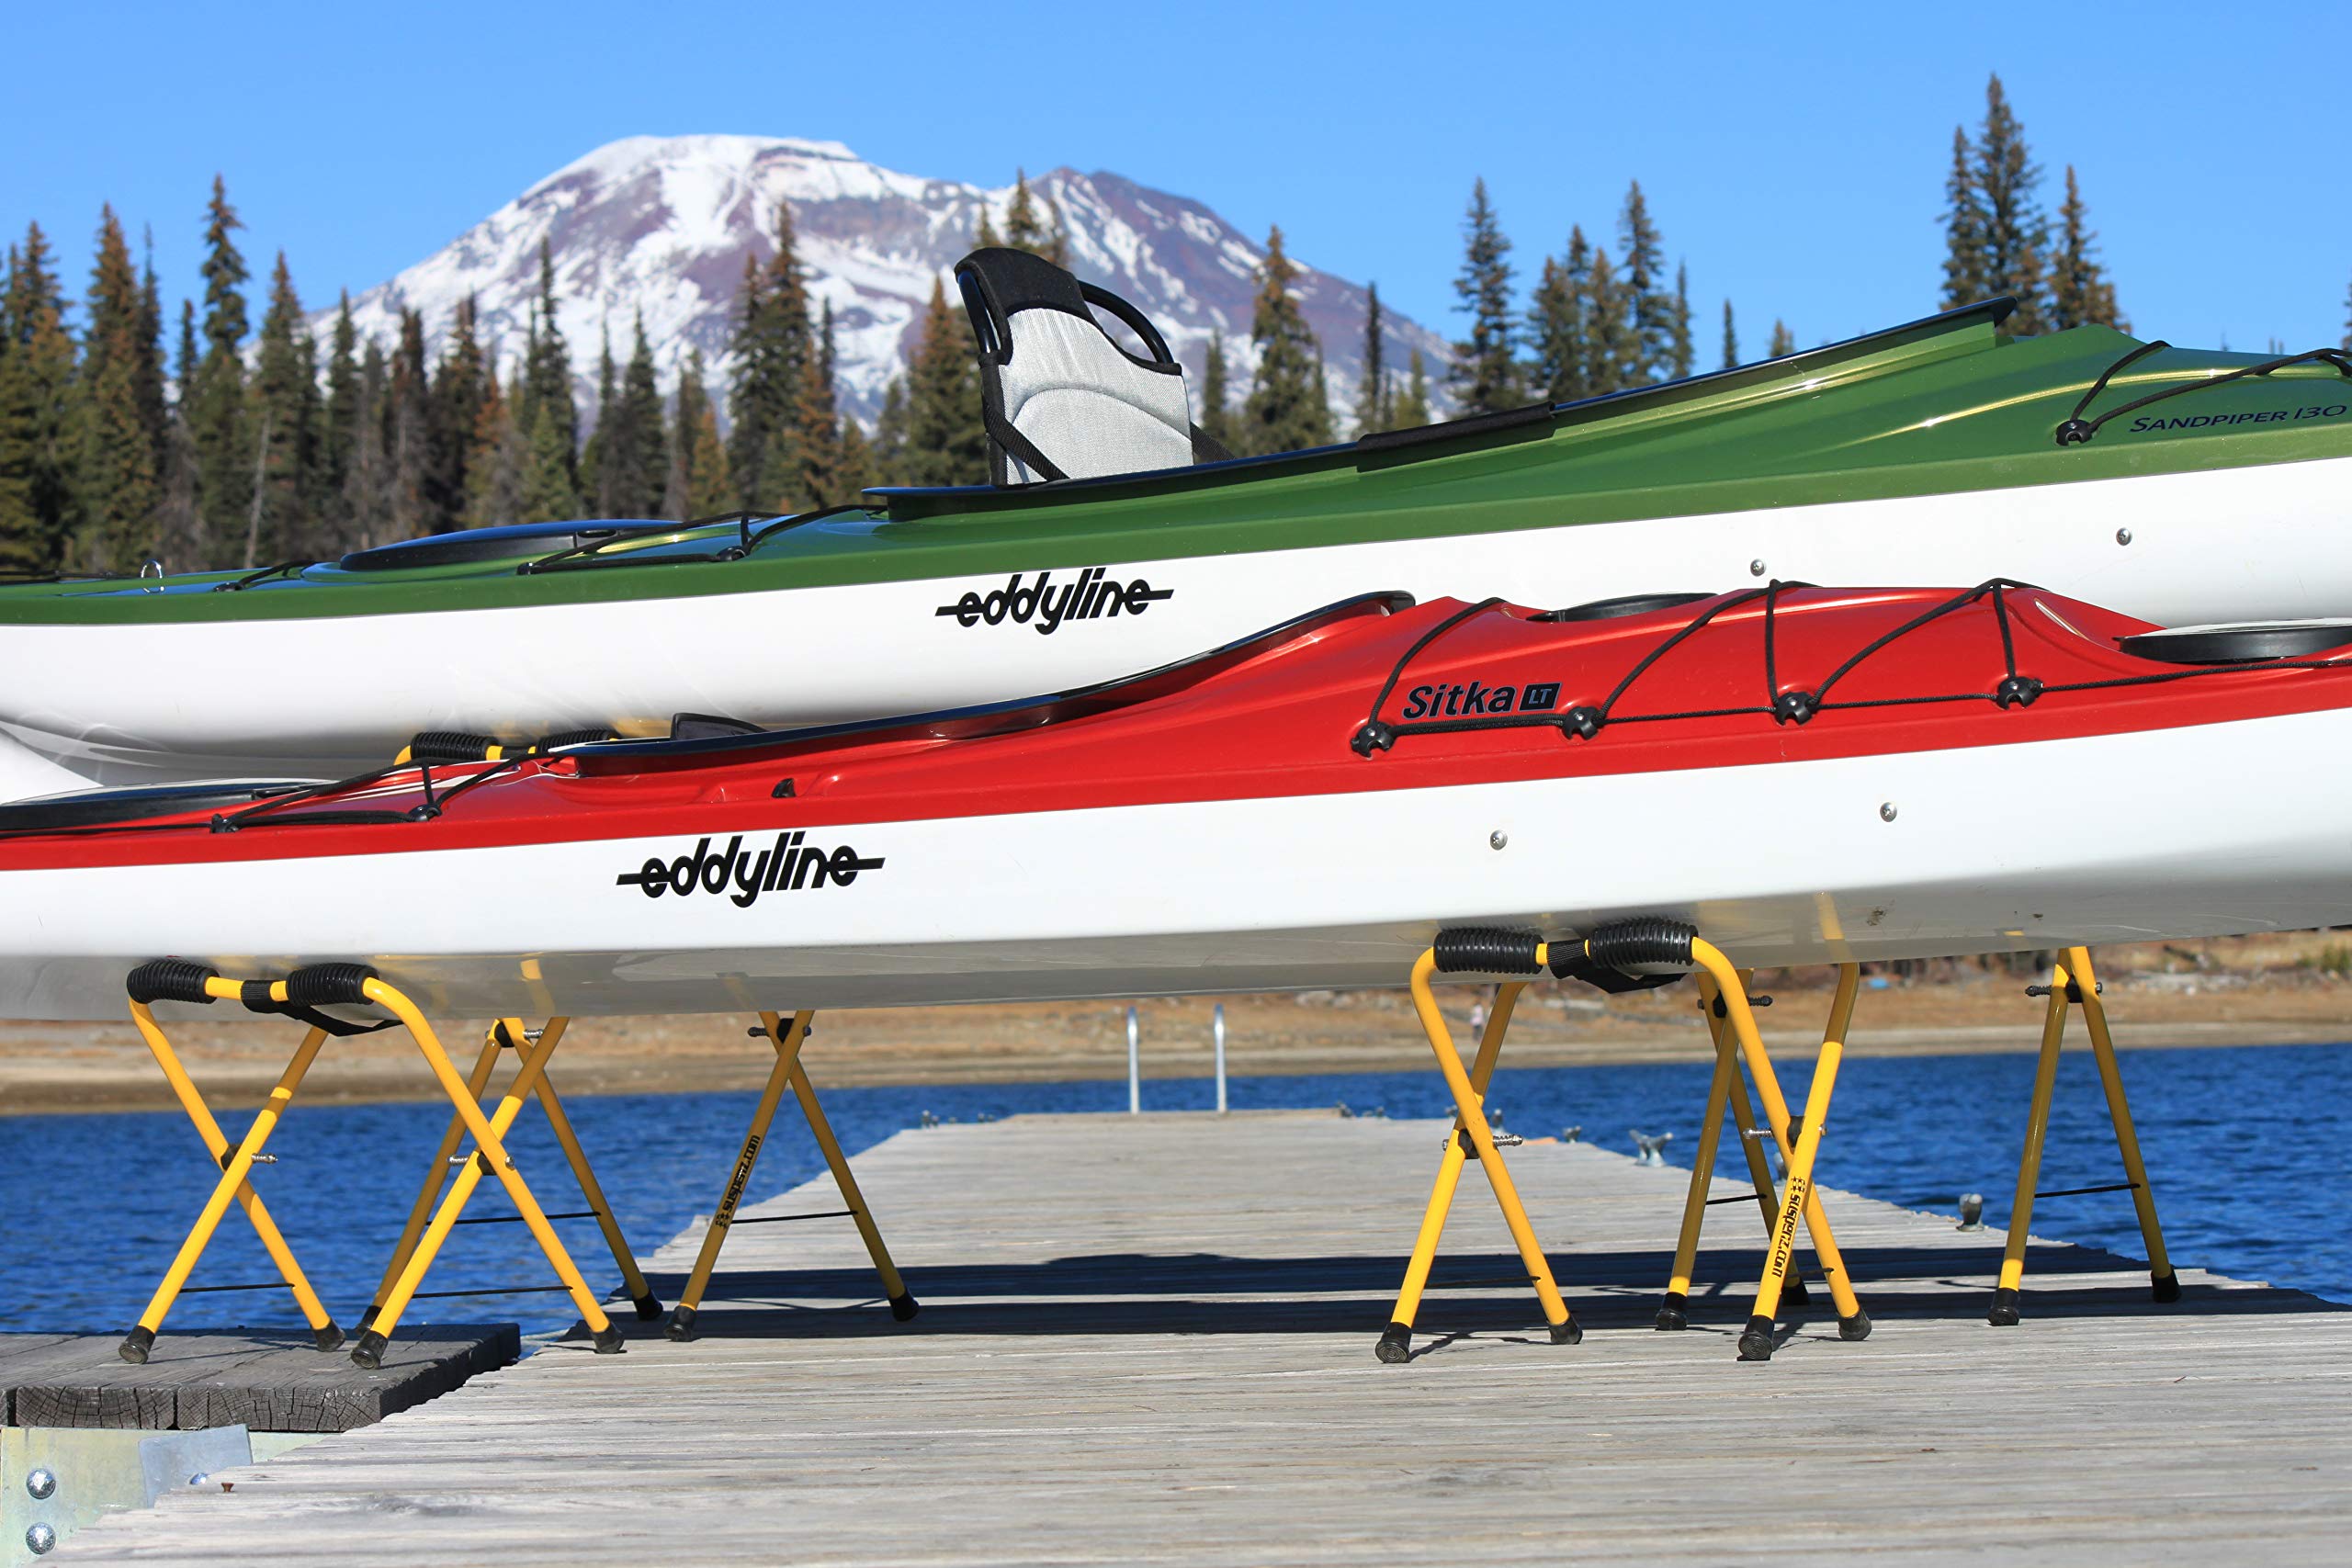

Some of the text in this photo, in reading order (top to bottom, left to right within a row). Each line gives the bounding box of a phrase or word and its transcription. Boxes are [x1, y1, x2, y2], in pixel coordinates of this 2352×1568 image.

[2130, 404, 2347, 433] SANDPIPER 130
[935, 567, 1174, 636] eddyline
[1402, 681, 1553, 720] Sitka LT
[616, 830, 886, 908] eddyline
